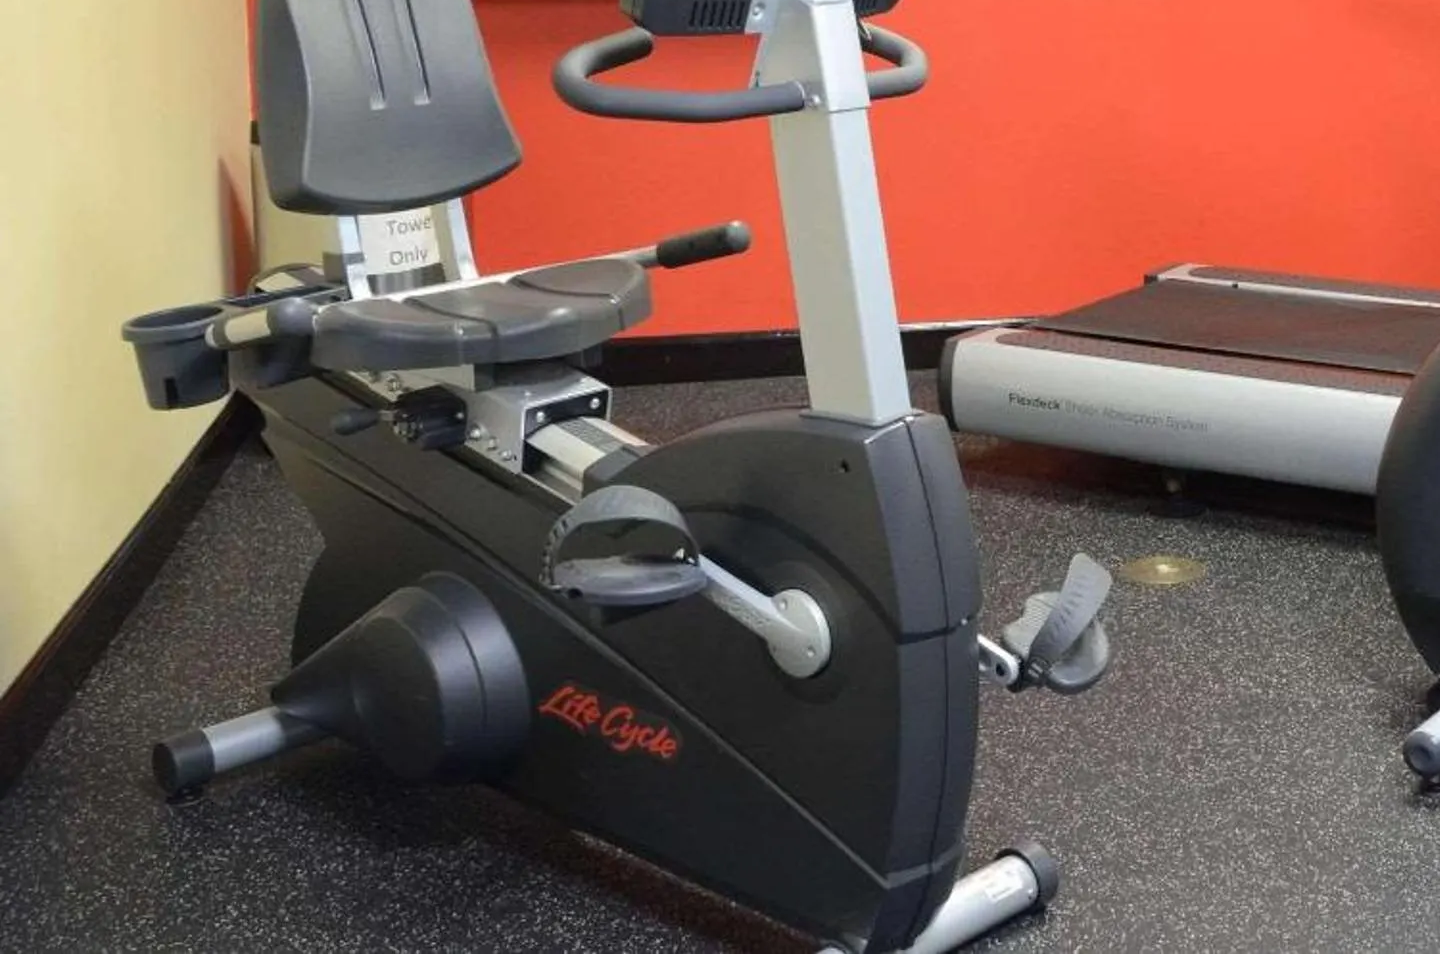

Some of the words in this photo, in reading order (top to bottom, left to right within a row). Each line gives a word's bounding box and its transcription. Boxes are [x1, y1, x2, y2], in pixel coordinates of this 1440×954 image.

[389, 246, 429, 266] Only
[539, 685, 601, 735] Life
[601, 705, 678, 759] Cycle
